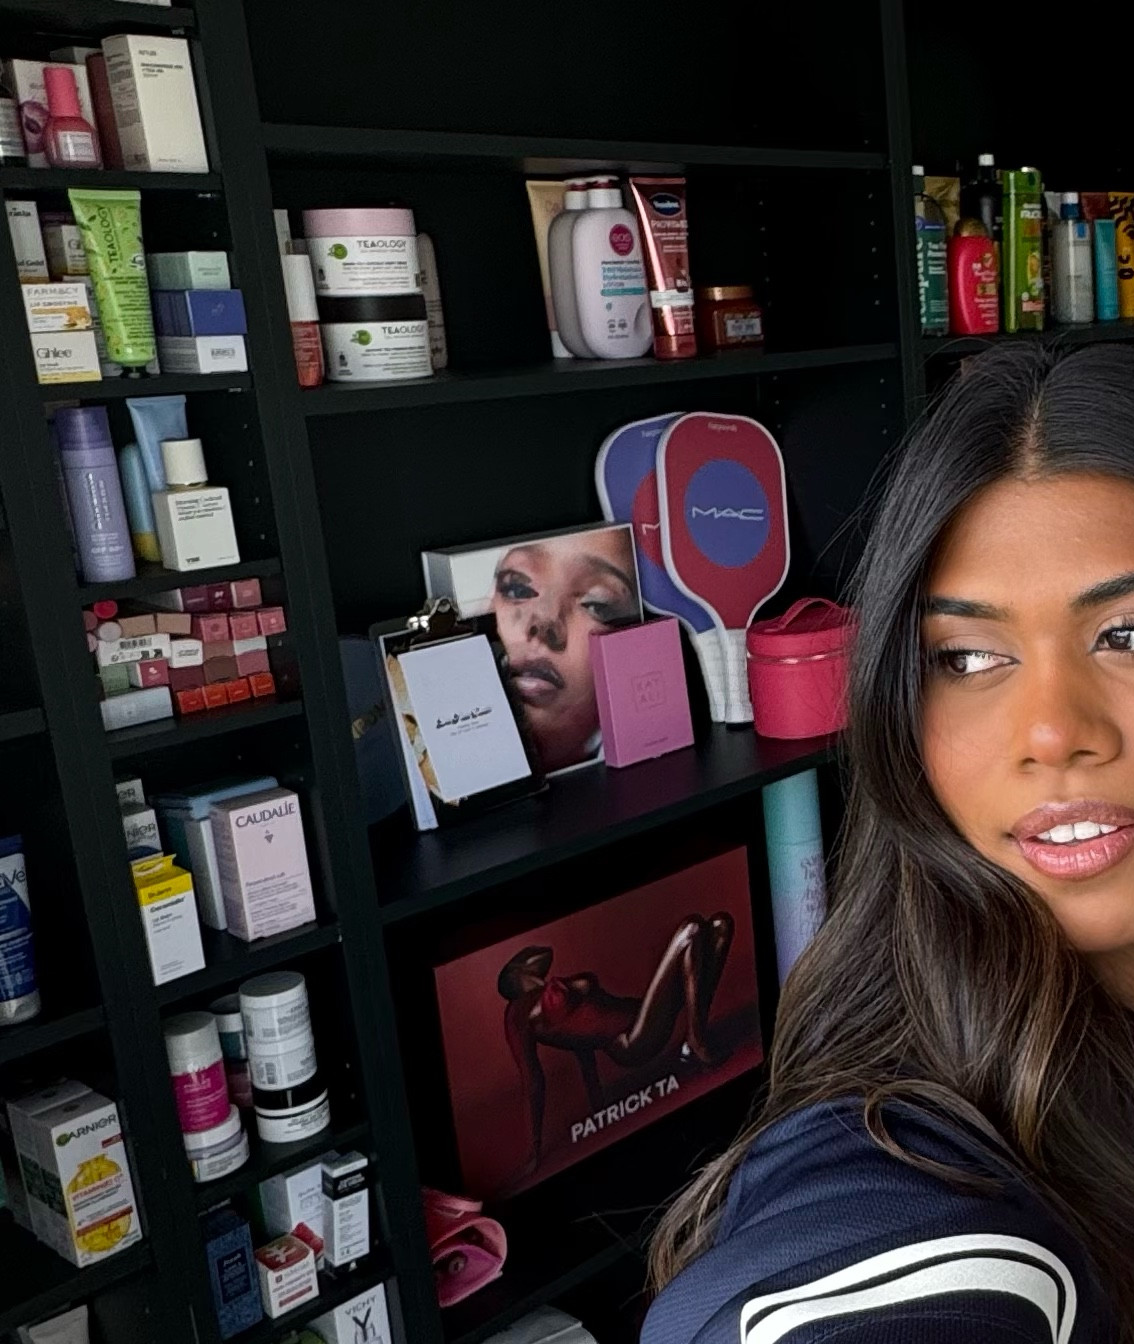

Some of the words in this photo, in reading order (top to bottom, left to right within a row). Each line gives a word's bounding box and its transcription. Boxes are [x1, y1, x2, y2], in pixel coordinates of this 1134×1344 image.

[356, 239, 407, 249] TEAOLOGY
[691, 506, 764, 522] MAC
[570, 1090, 653, 1144] PATRICK
[655, 1073, 680, 1099] TA
[344, 1294, 377, 1316] VICHY
